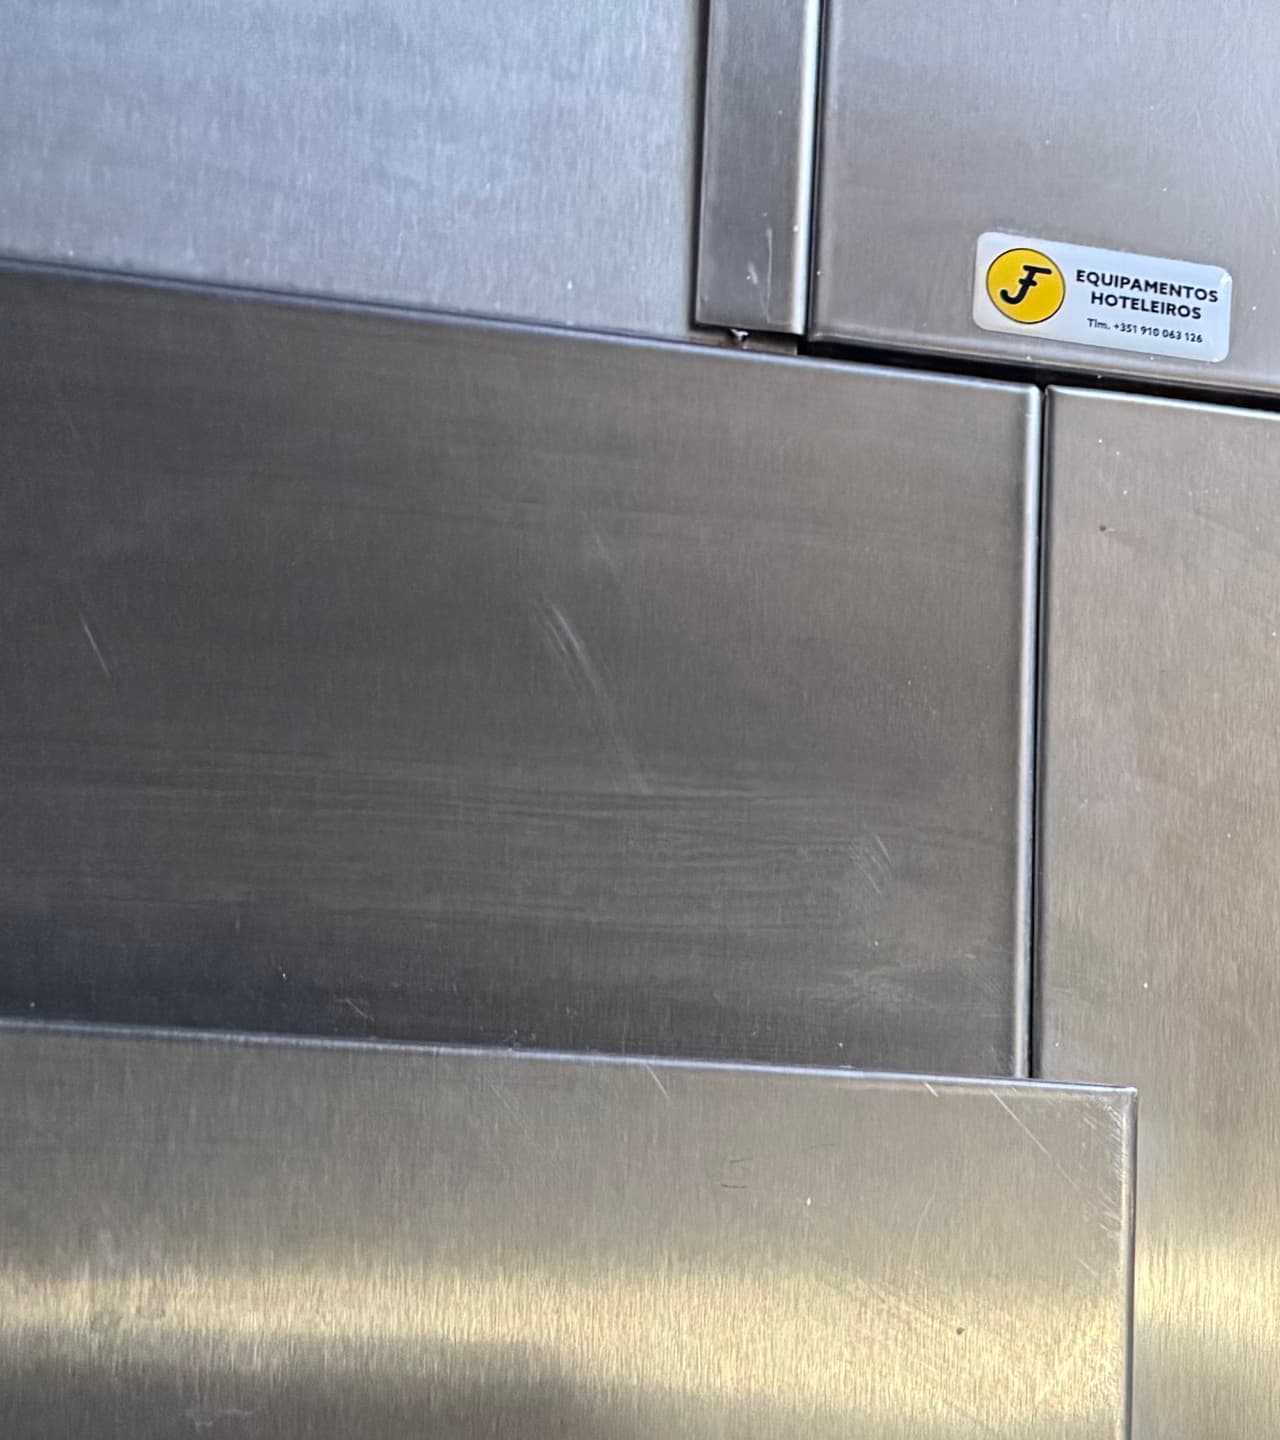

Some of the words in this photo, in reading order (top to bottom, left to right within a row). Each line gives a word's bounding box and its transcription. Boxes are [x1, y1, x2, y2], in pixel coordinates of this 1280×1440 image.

[1076, 269, 1219, 303] EQUIPAMENTOS
[1090, 291, 1202, 319] HOTELEIROS
[1087, 317, 1111, 330] Tlm.
[1113, 322, 1138, 334] +351
[1140, 325, 1160, 337] 910
[1184, 331, 1204, 344] 126
